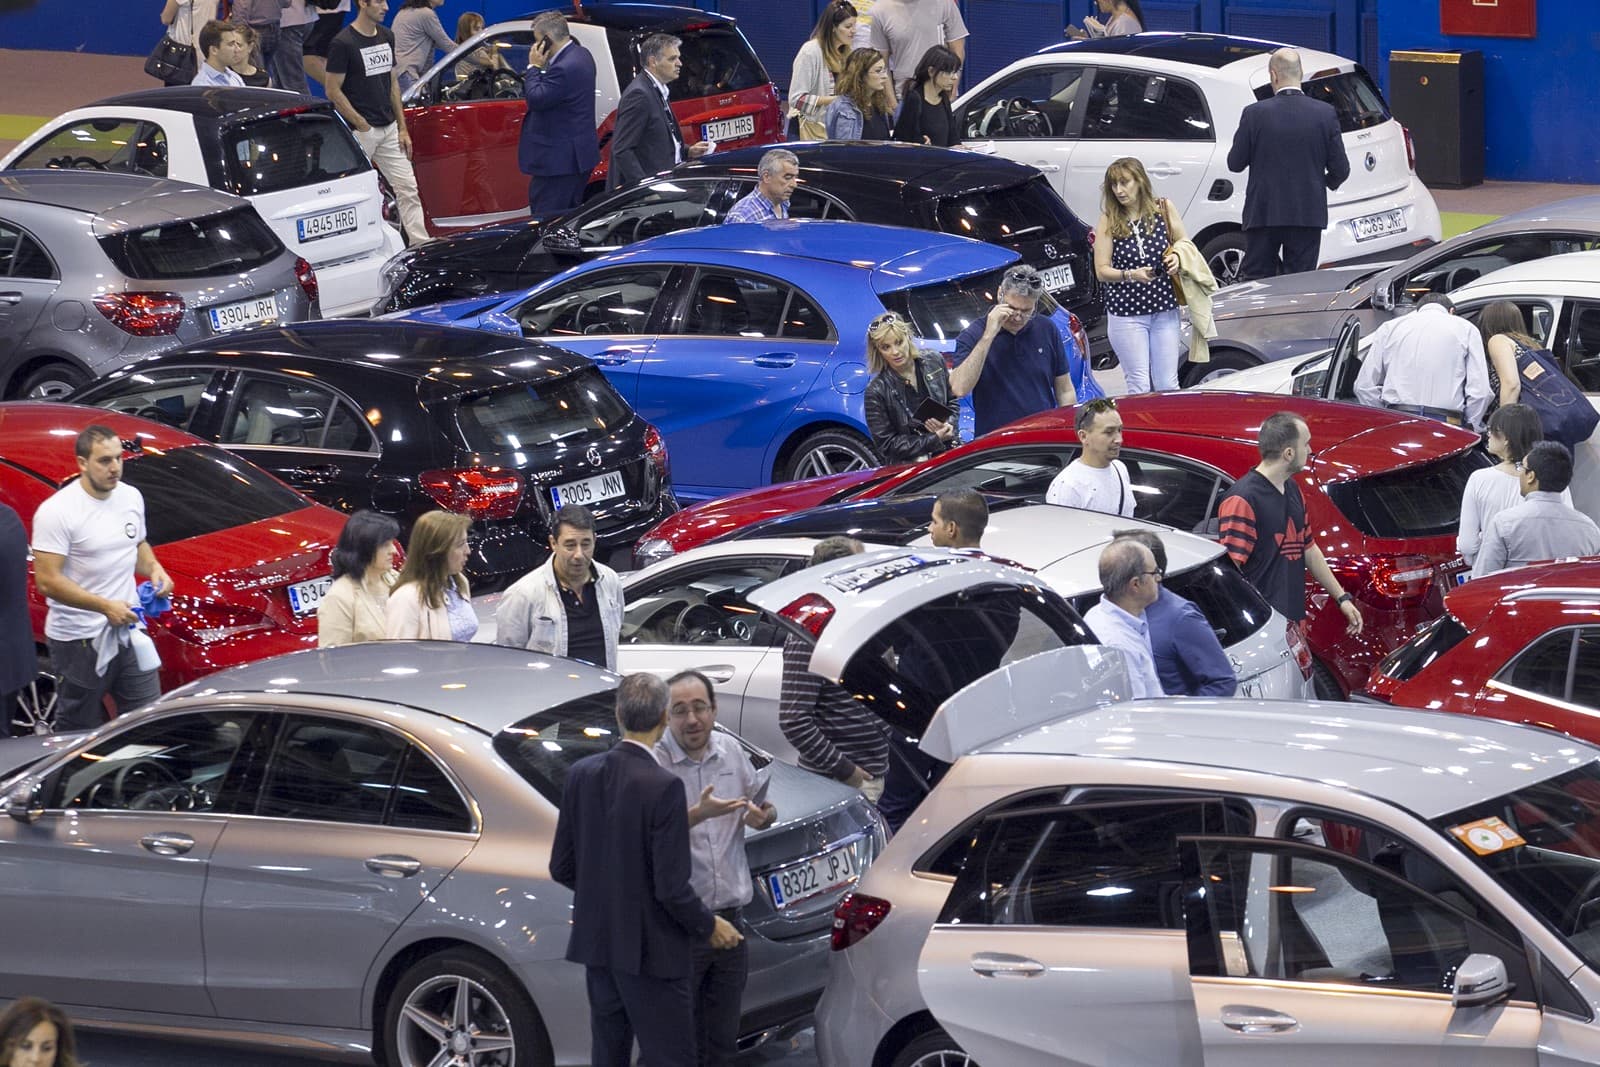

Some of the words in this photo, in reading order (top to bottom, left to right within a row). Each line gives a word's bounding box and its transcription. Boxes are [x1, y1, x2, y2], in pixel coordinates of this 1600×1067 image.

[369, 52, 389, 65] NOW
[708, 122, 732, 139] 5171
[735, 118, 753, 135] HRS
[306, 216, 333, 234] 4945
[335, 211, 354, 229] HRG
[1052, 266, 1071, 286] HVF
[220, 304, 250, 325] 3904
[254, 299, 274, 318] JRH
[561, 482, 592, 505] 3005
[600, 474, 623, 496] JNN
[782, 865, 819, 898] 8322
[827, 852, 850, 881] JPJ
